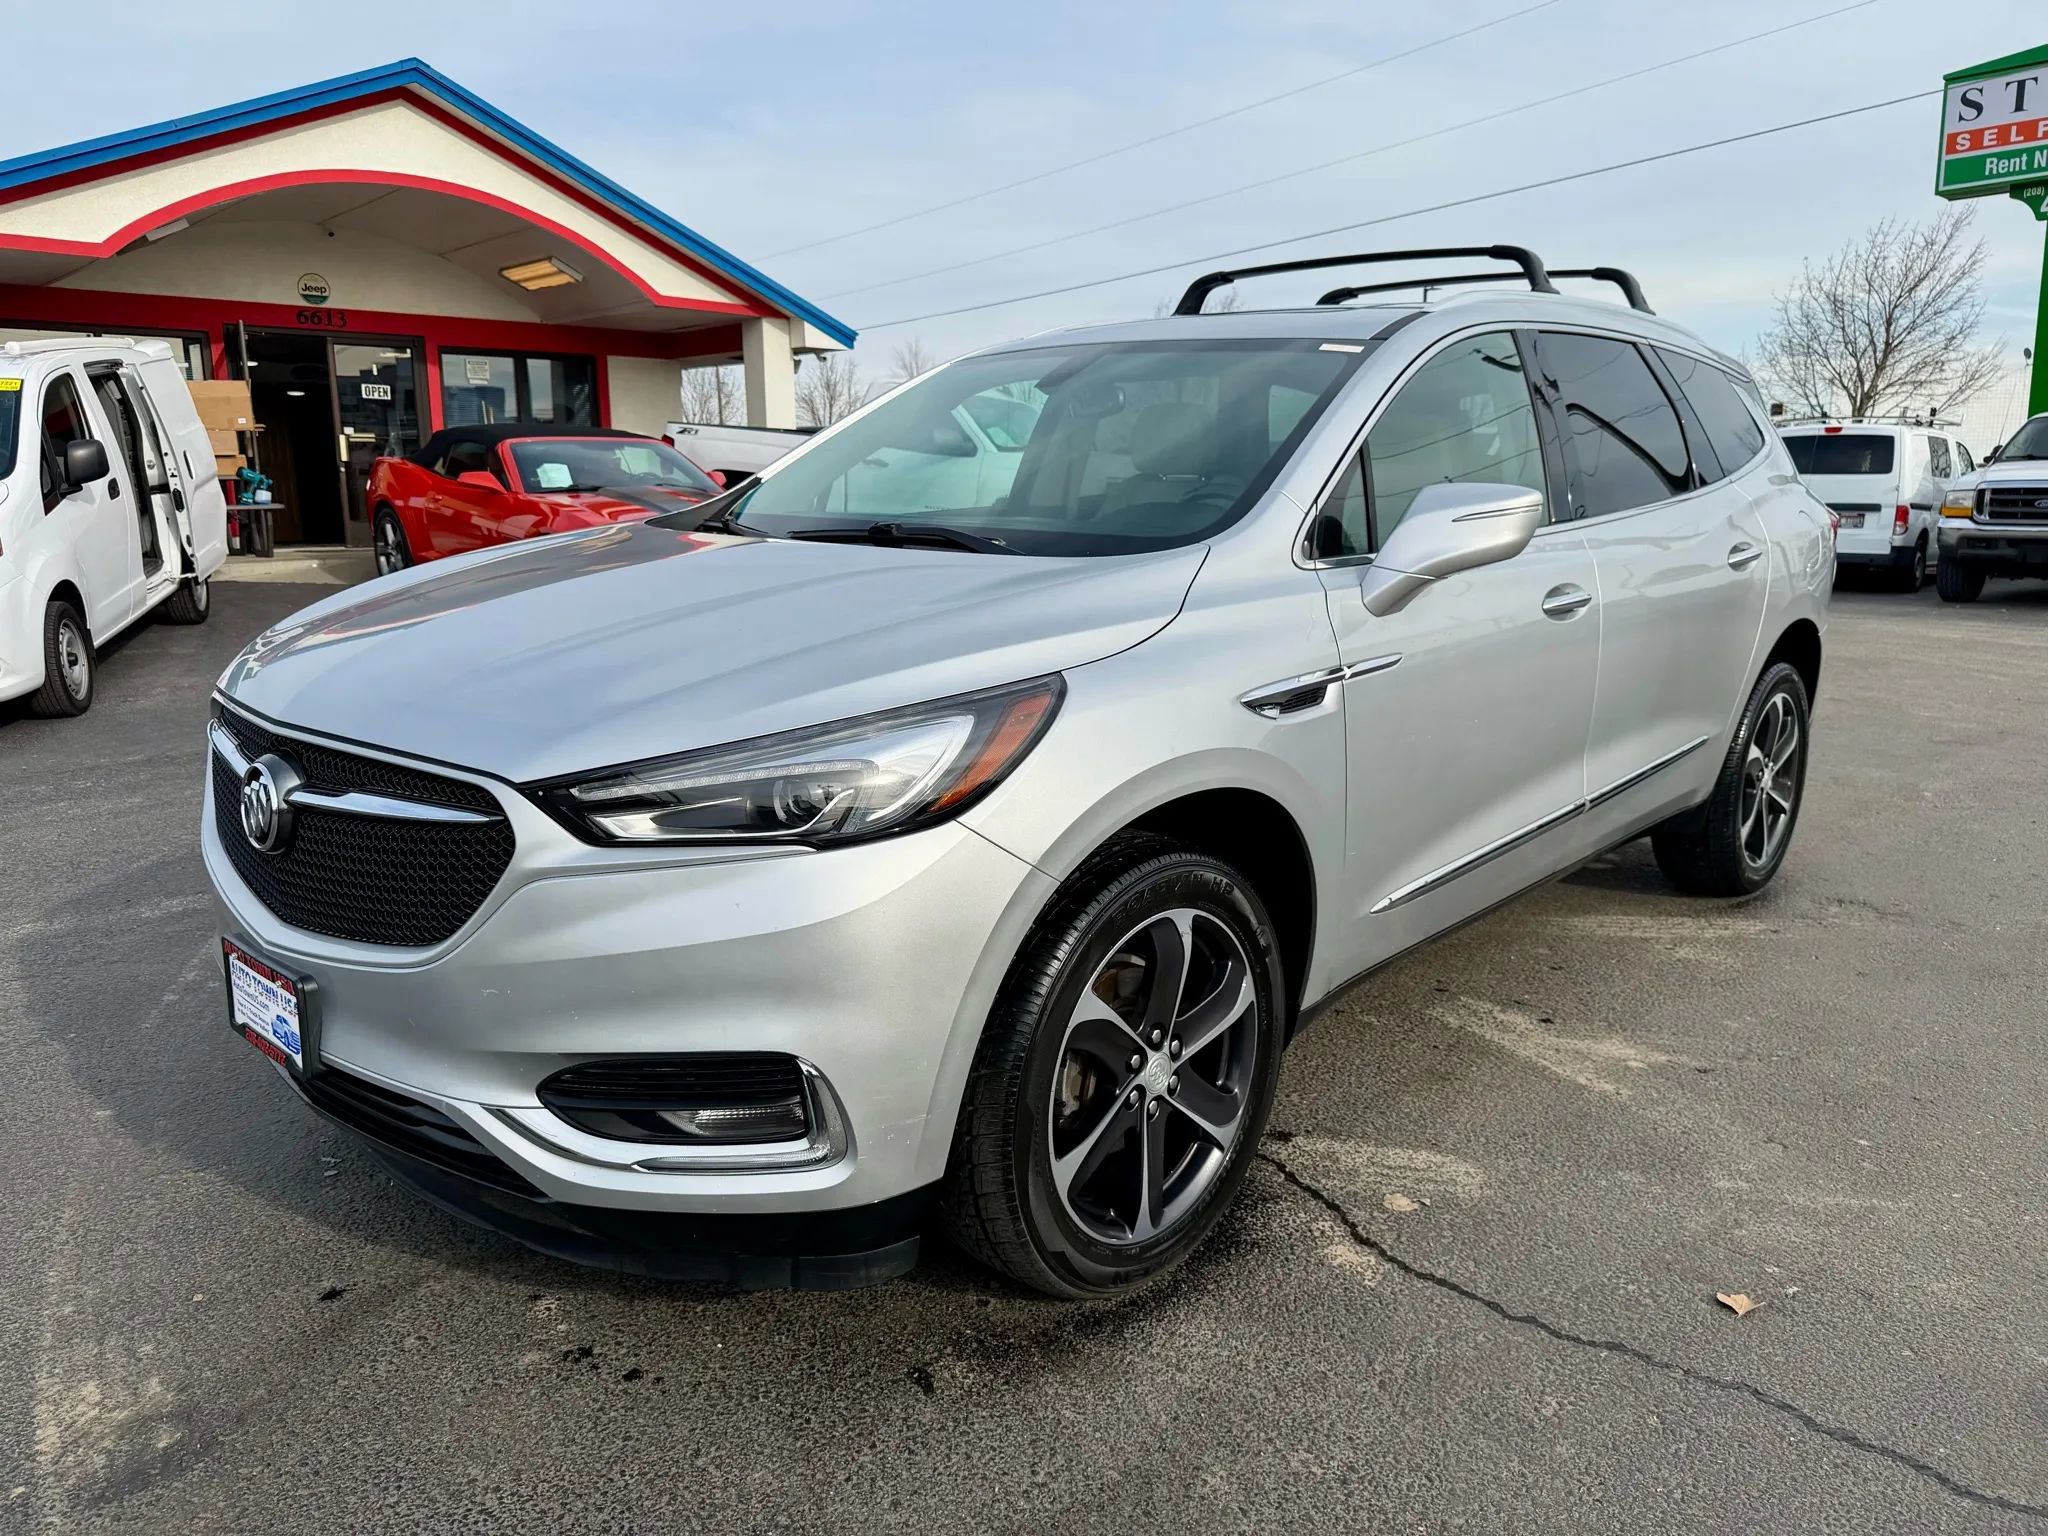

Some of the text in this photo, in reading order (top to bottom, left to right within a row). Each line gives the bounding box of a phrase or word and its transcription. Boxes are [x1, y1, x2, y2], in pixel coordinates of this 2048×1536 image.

[1955, 120, 2048, 151] SELF
[1985, 153, 2028, 176] Rent
[2023, 185, 2045, 199] (208)
[301, 283, 327, 295] Jeep
[296, 310, 347, 328] 6613
[364, 385, 389, 399] OPEN
[246, 953, 273, 982] TOWN
[252, 974, 280, 1007] TOWN
